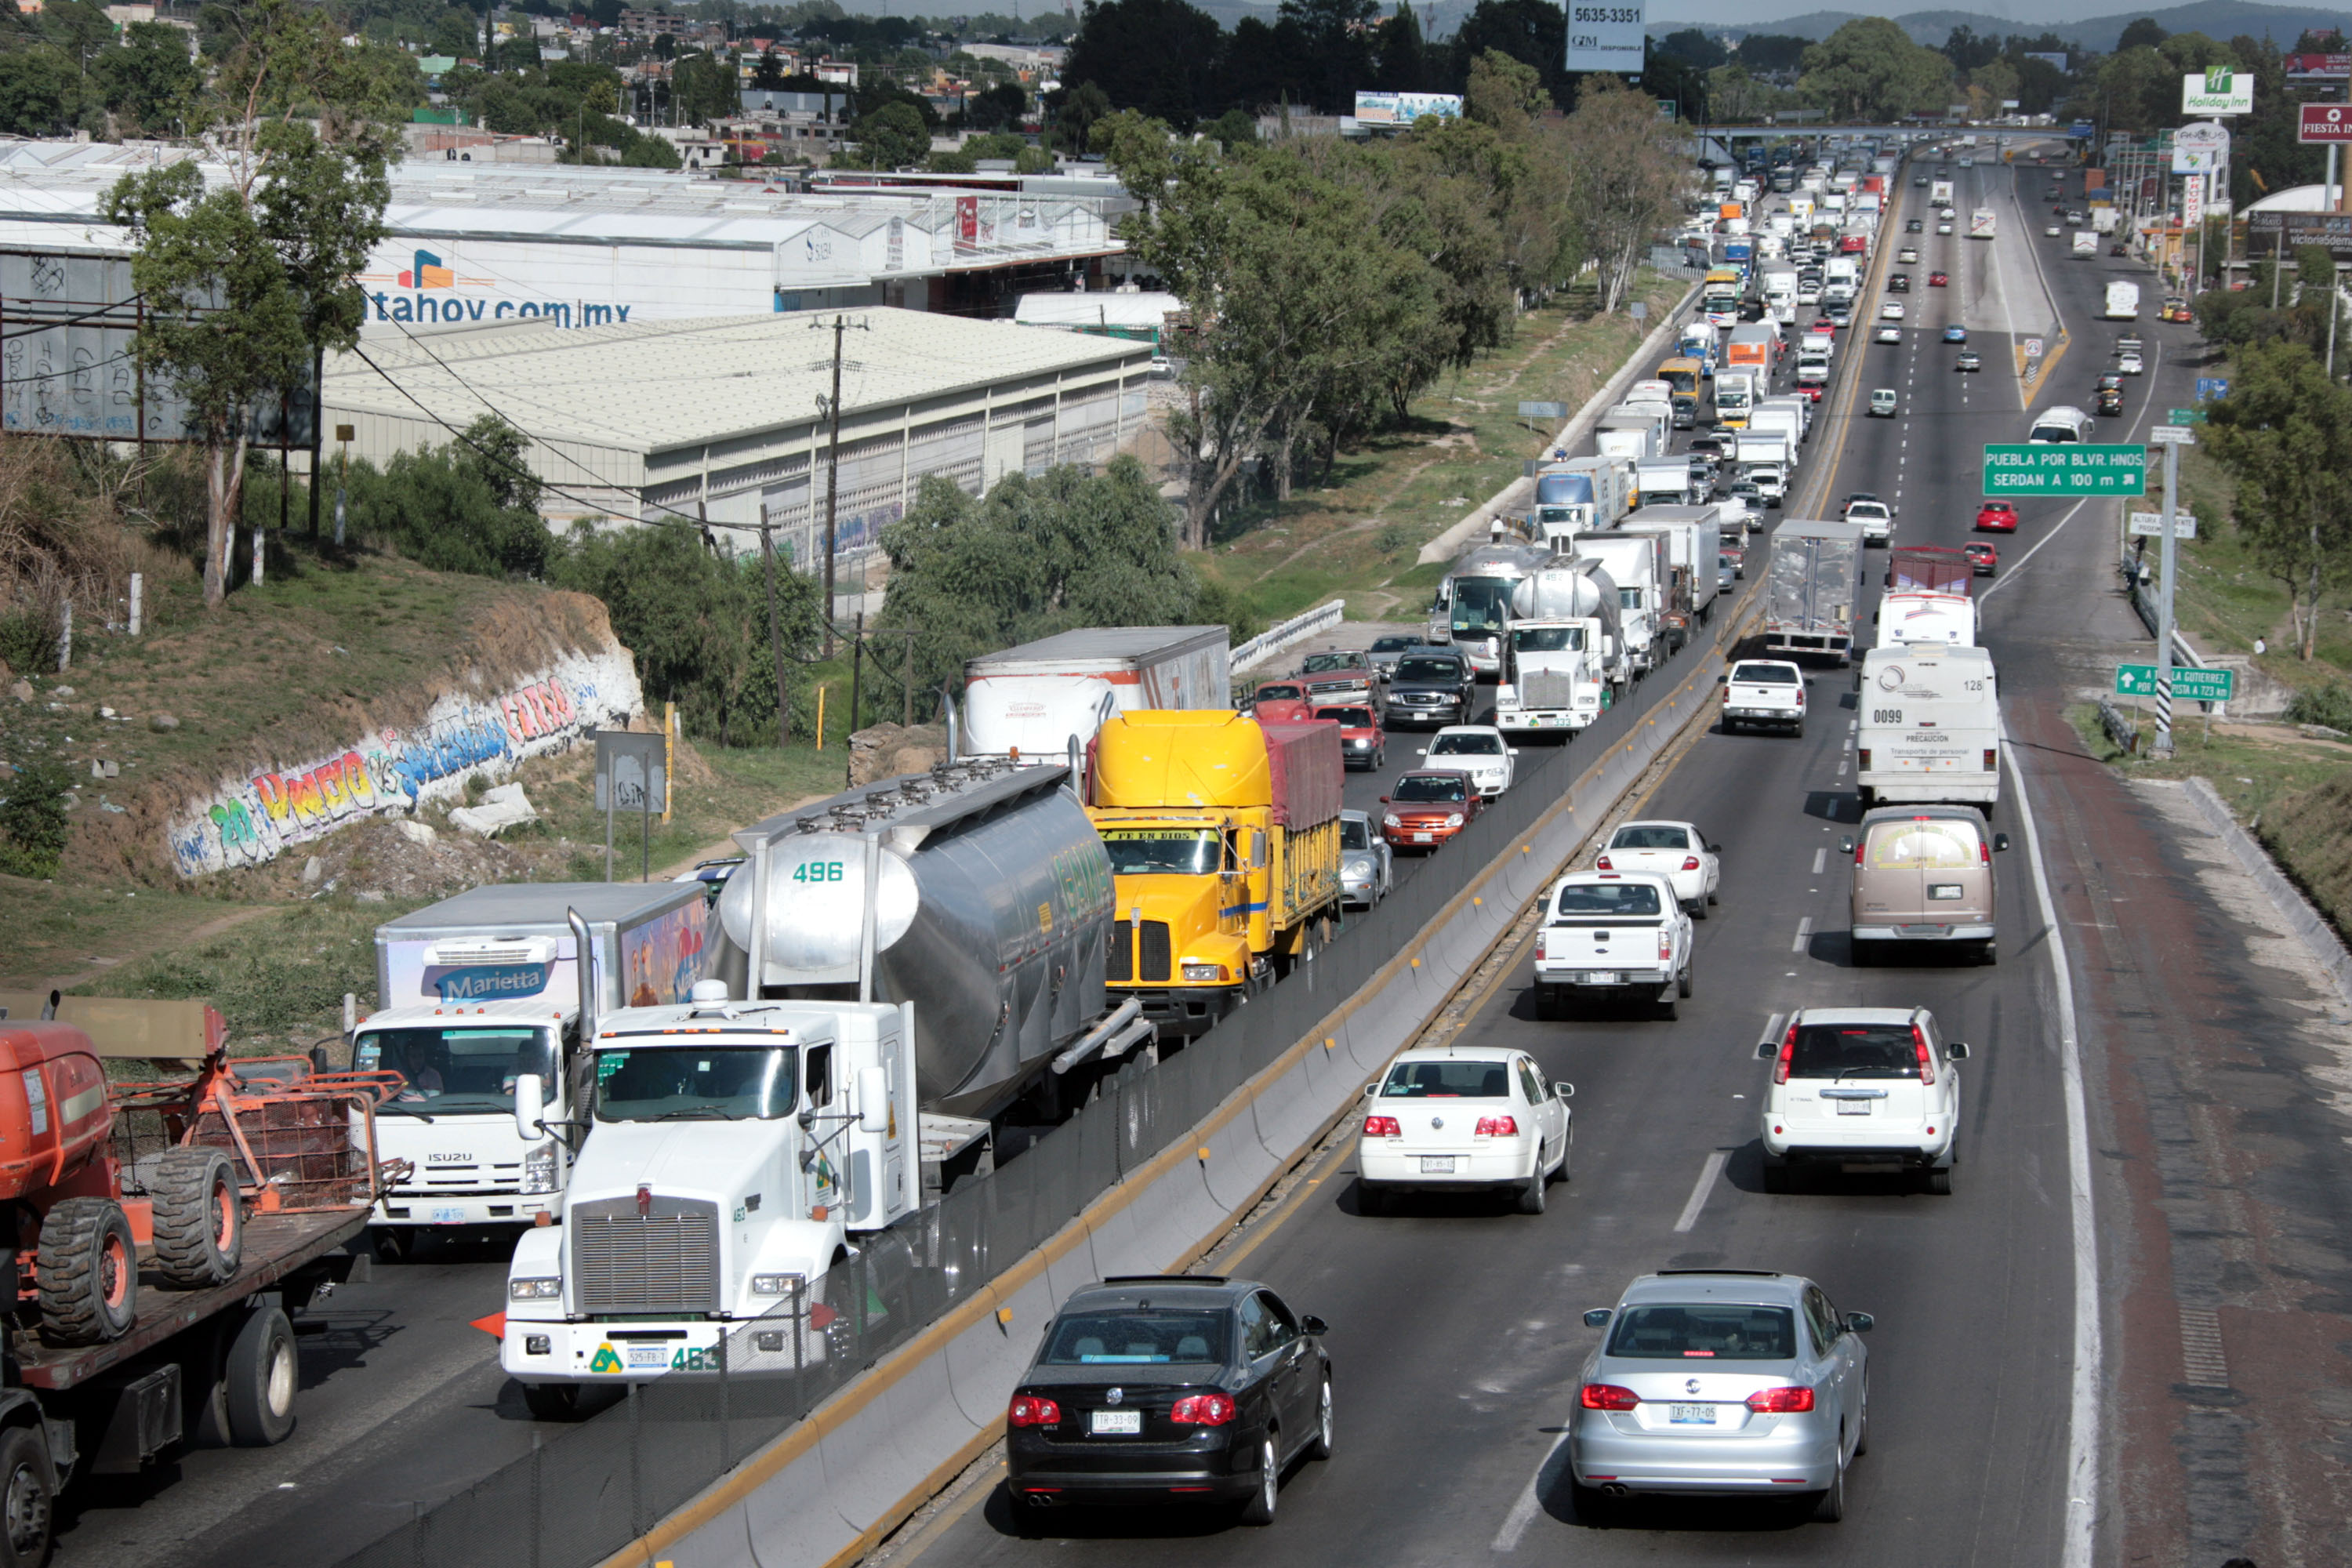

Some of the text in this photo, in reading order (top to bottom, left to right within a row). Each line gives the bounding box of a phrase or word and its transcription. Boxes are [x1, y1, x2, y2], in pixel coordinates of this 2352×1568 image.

[1575, 7, 1640, 23] 5635-3351
[2187, 96, 2249, 109] Holiday Inn
[2303, 123, 2340, 133] FIESTA
[1986, 453, 2144, 466] PUEBLA POR BLVR. HNOS.
[1994, 474, 2114, 486] SERDAN A 100 m
[2146, 669, 2151, 679] A
[2184, 671, 2225, 684] GUTIERREZ
[1964, 680, 1983, 691] 128
[2137, 681, 2152, 692] POR
[2193, 685, 2198, 695] A
[2201, 685, 2214, 696] 723
[2216, 688, 2227, 697] km
[1555, 717, 1571, 727] 333
[1874, 710, 1902, 724] 0099
[1940, 748, 1969, 757] personal
[793, 862, 844, 883] 496
[446, 971, 540, 1002] Marietta
[428, 1153, 472, 1162] ISUZU
[1094, 1413, 1138, 1426] TTR-33-09
